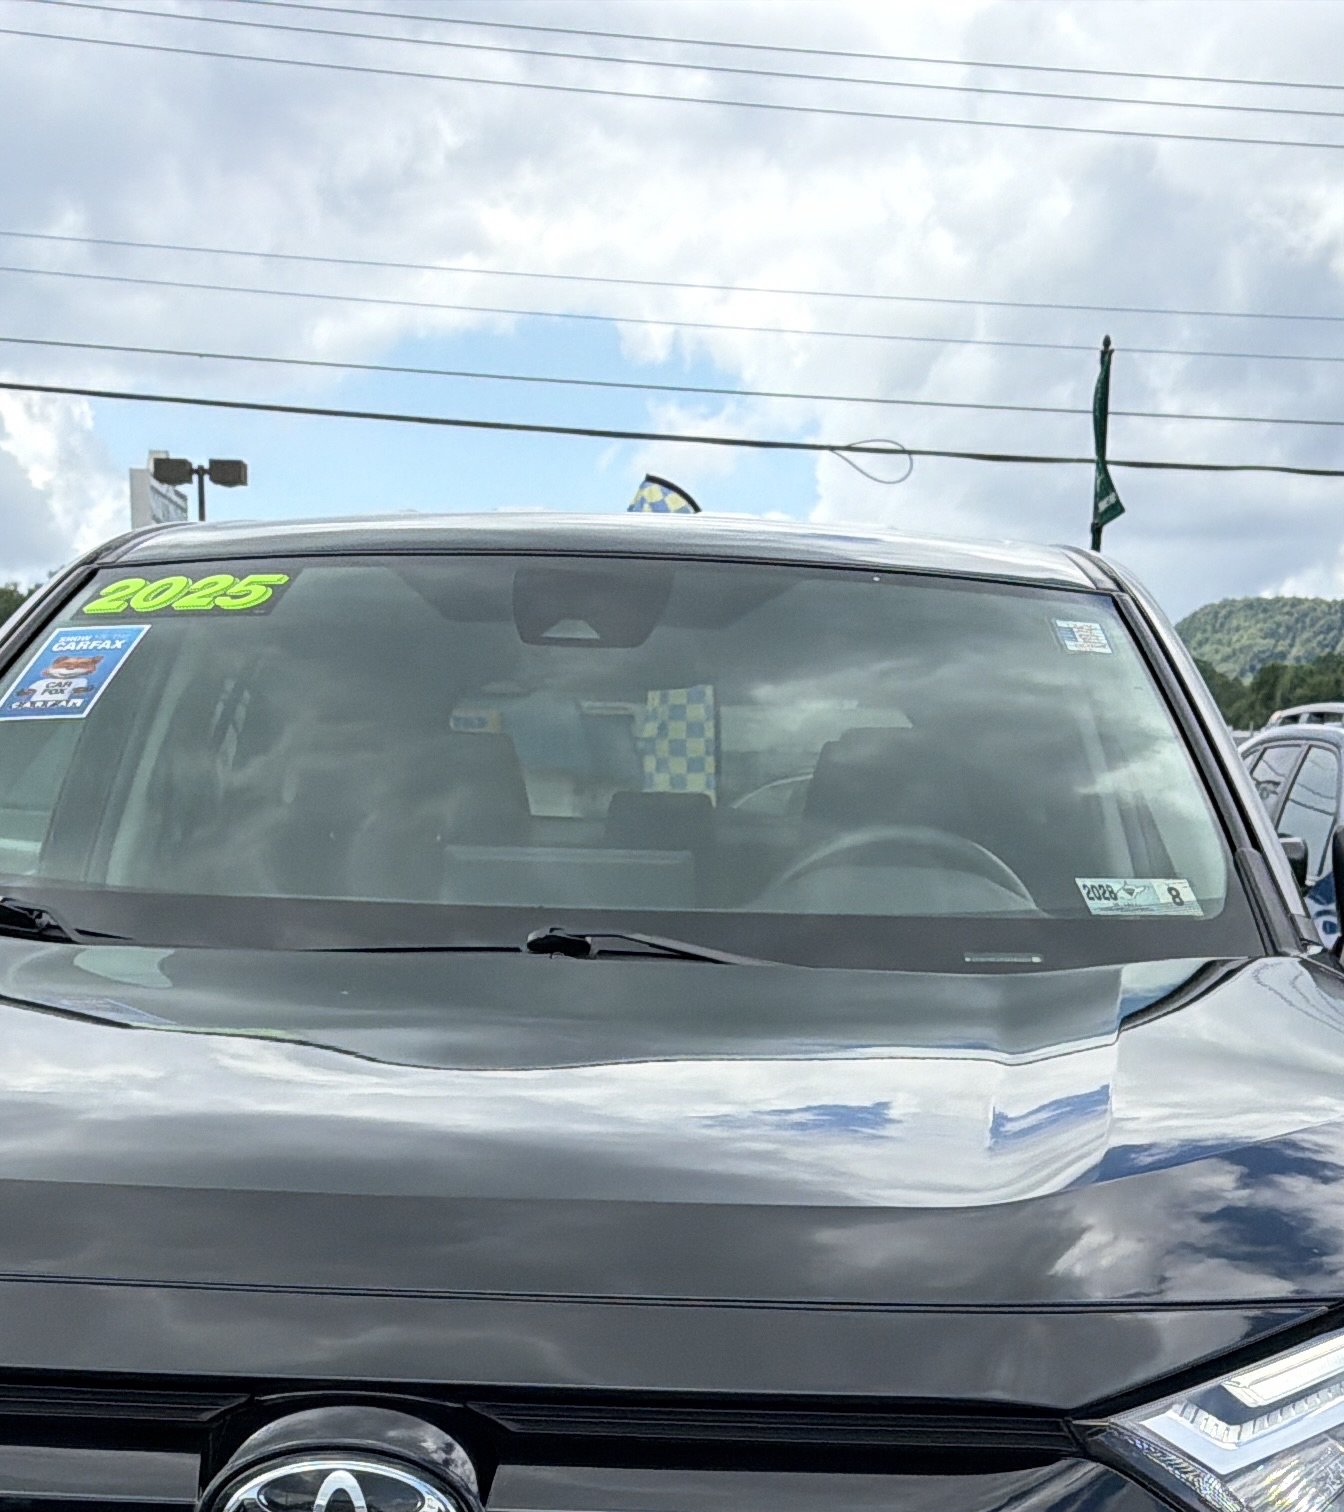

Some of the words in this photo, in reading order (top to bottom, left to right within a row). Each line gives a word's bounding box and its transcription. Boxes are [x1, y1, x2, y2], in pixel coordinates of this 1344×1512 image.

[83, 574, 289, 614] 2025
[51, 639, 125, 652] CARFAX
[45, 681, 73, 689] CAR
[1166, 886, 1185, 906] 8
